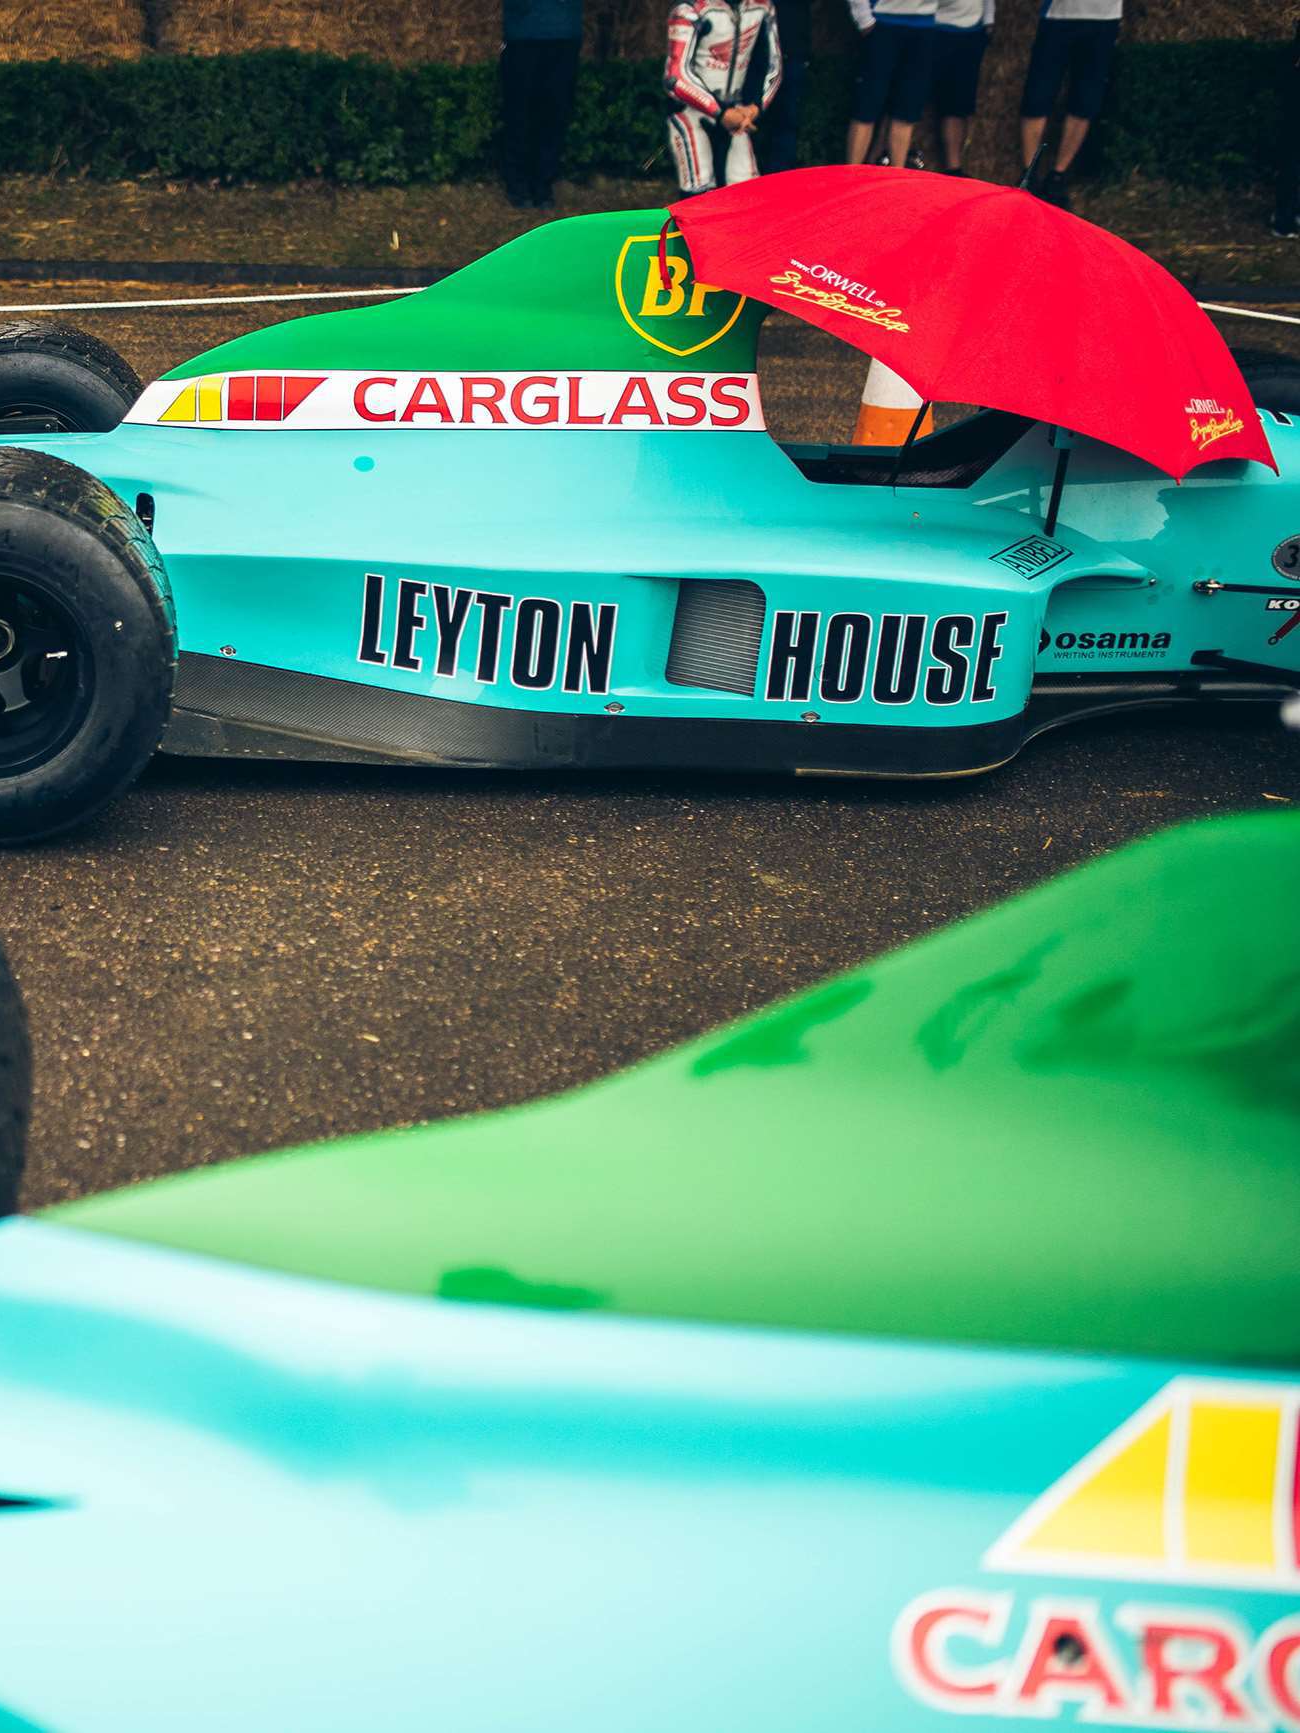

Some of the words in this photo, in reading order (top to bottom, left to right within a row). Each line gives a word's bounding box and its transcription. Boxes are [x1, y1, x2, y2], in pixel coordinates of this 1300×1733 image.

[352, 375, 750, 427] CARGLASS
[357, 573, 618, 695] LEYTON
[764, 610, 1009, 707] HOUSE
[1053, 651, 1095, 659] WRITING
[1098, 650, 1167, 659] INSTRUMENTS
[1055, 632, 1172, 649] osama
